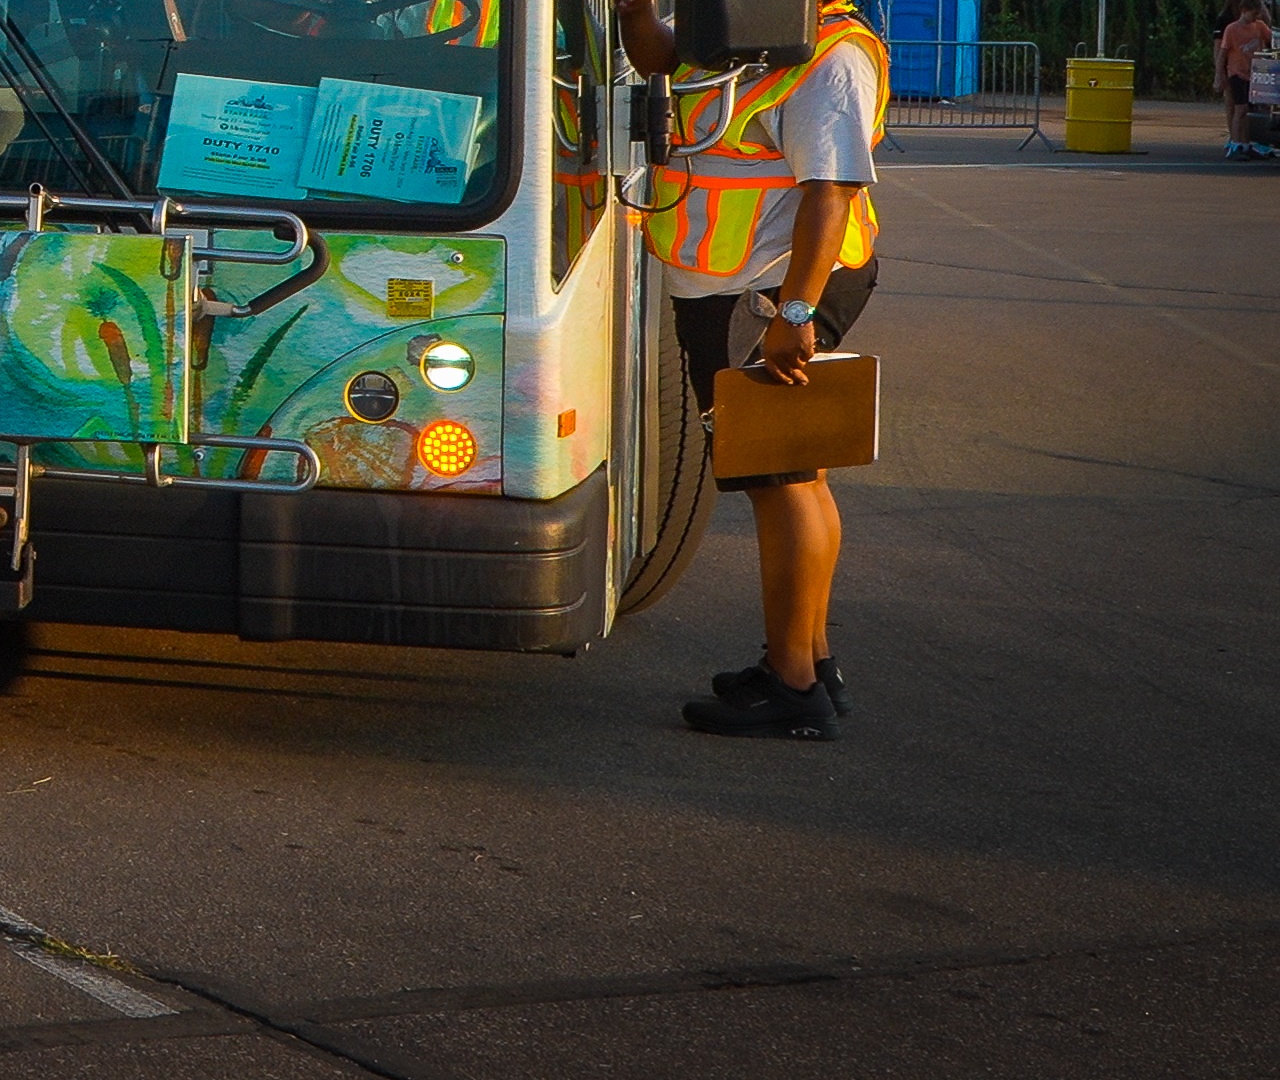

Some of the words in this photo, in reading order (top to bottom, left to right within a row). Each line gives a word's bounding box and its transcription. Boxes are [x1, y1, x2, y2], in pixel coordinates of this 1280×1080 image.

[203, 137, 243, 150] DUTY
[247, 144, 280, 155] 1710
[368, 119, 383, 150] DUTY
[360, 153, 375, 177] 1706
